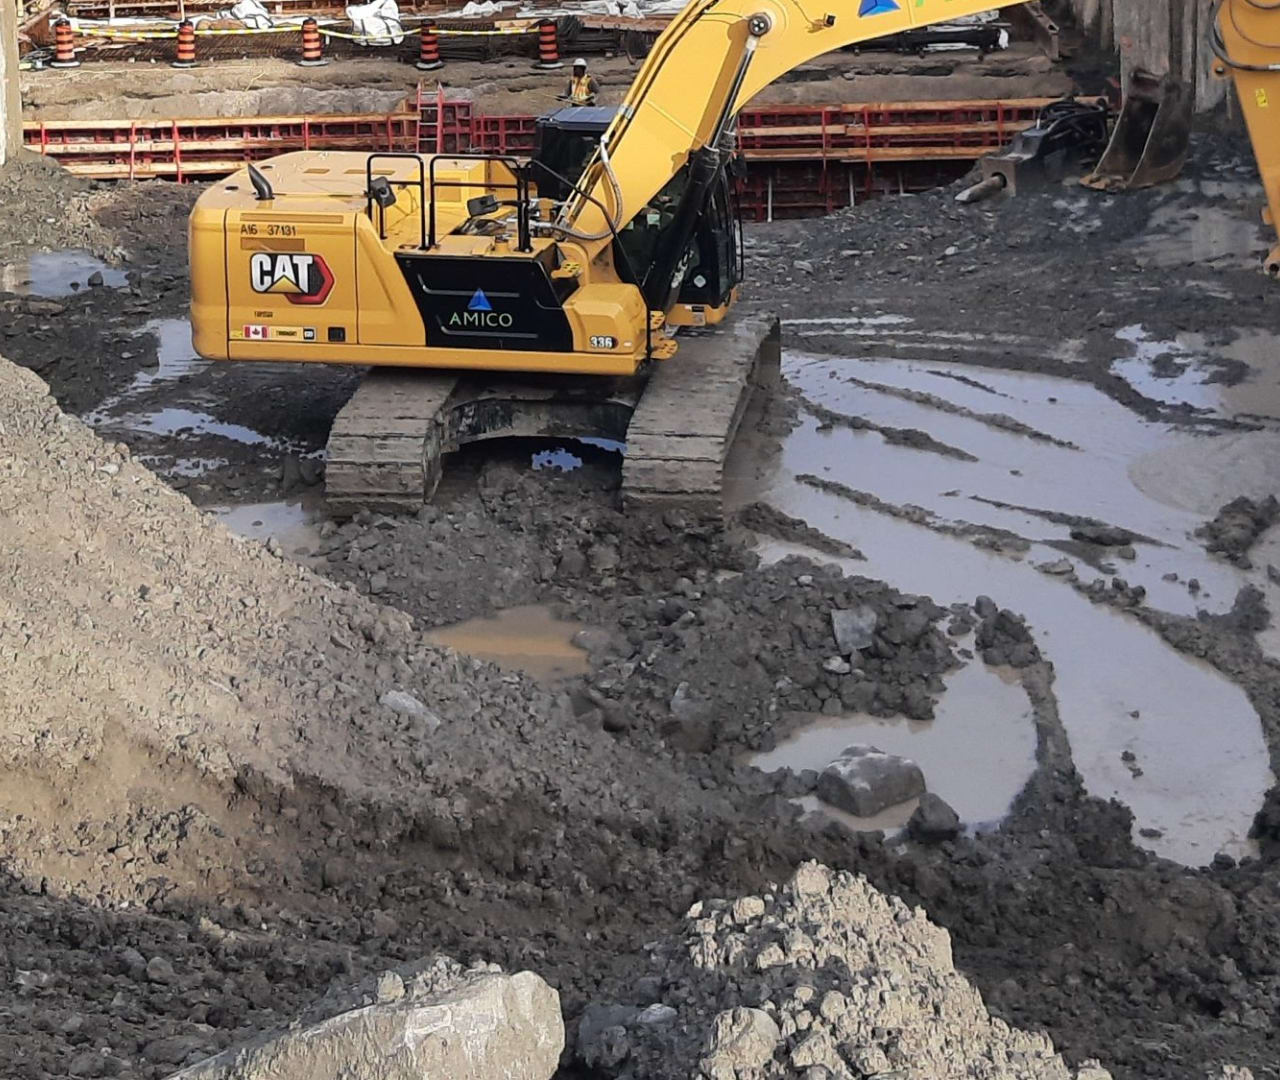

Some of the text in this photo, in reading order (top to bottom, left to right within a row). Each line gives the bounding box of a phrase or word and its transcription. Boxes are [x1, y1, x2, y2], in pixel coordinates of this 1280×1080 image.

[267, 224, 296, 236] 37131
[251, 253, 313, 293] CAT
[449, 312, 513, 327] AMICO
[590, 336, 613, 348] 336
